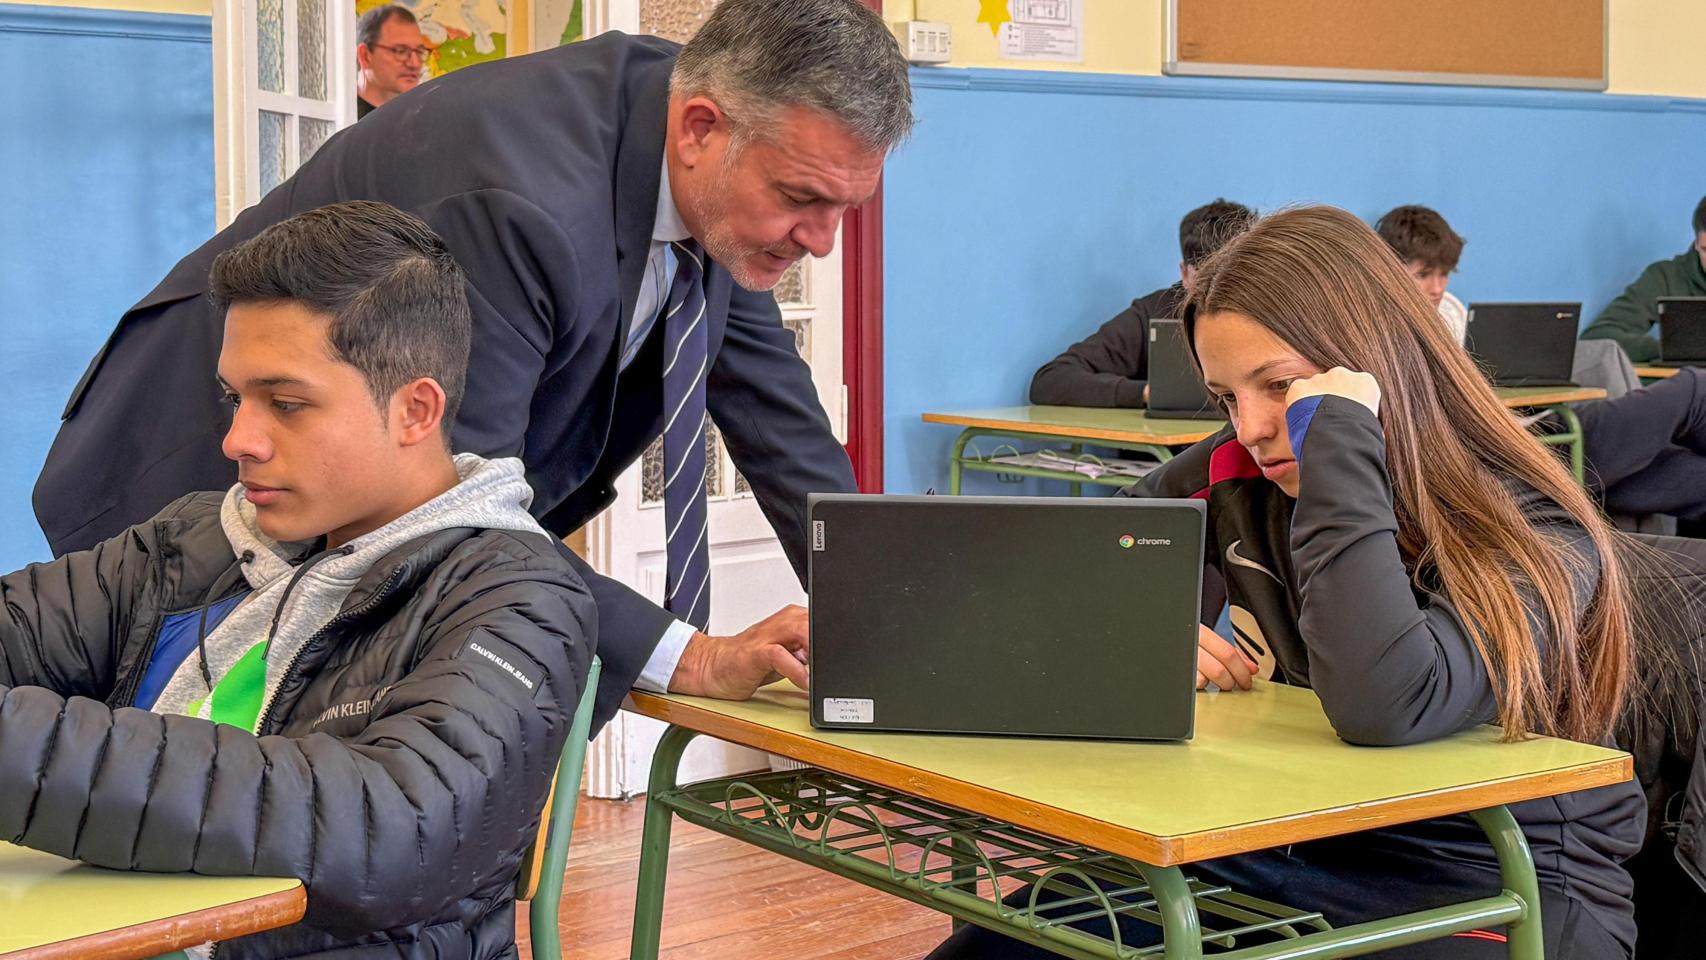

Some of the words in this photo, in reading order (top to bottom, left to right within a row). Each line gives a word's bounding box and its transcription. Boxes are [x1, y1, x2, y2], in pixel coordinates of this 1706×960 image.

[1137, 537, 1172, 546] chrome
[470, 643, 497, 662] CALVIN
[494, 656, 516, 674] KLEIN
[341, 700, 374, 718] KLEIN
